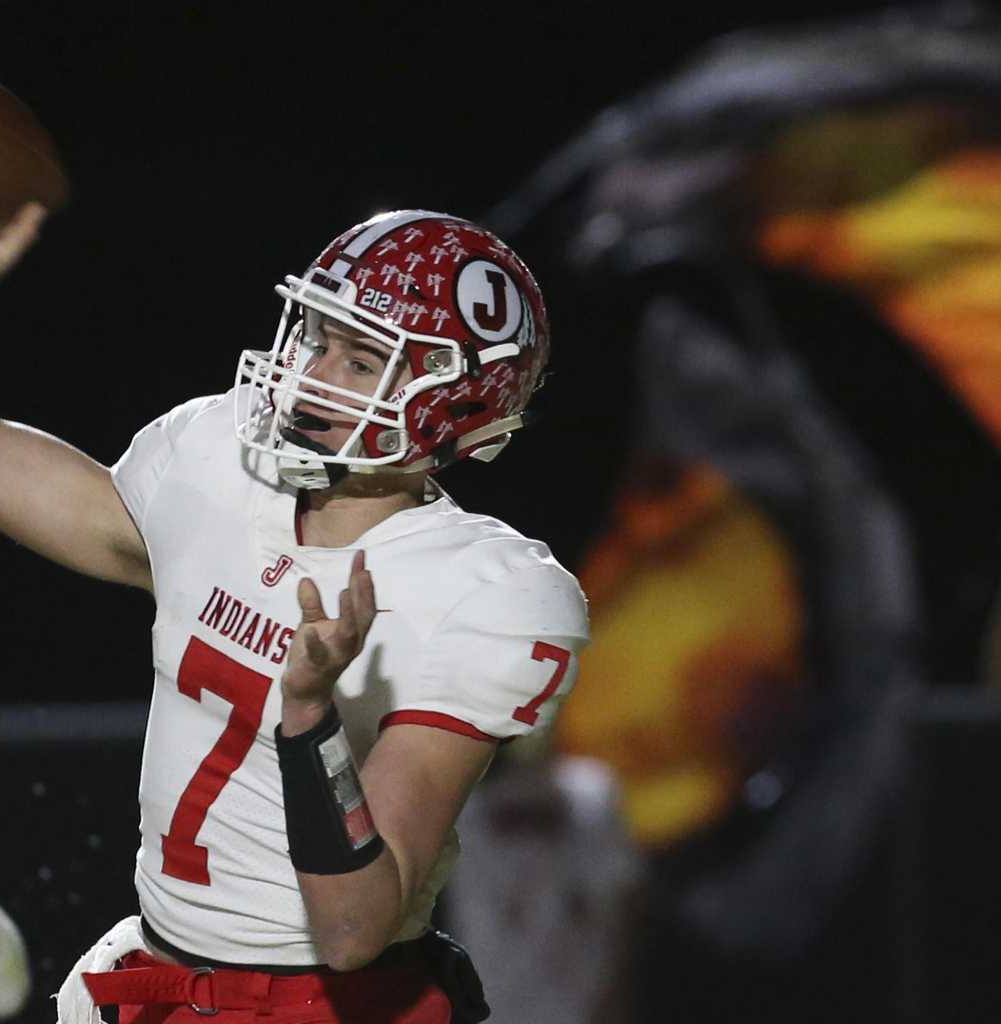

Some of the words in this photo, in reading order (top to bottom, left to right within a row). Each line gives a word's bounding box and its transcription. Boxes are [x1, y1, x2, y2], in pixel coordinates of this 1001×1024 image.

[360, 288, 392, 313] 212
[473, 270, 507, 332] J
[261, 554, 293, 588] J
[198, 586, 297, 665] INDIANS
[511, 640, 571, 727] 7
[160, 633, 274, 887] 7
